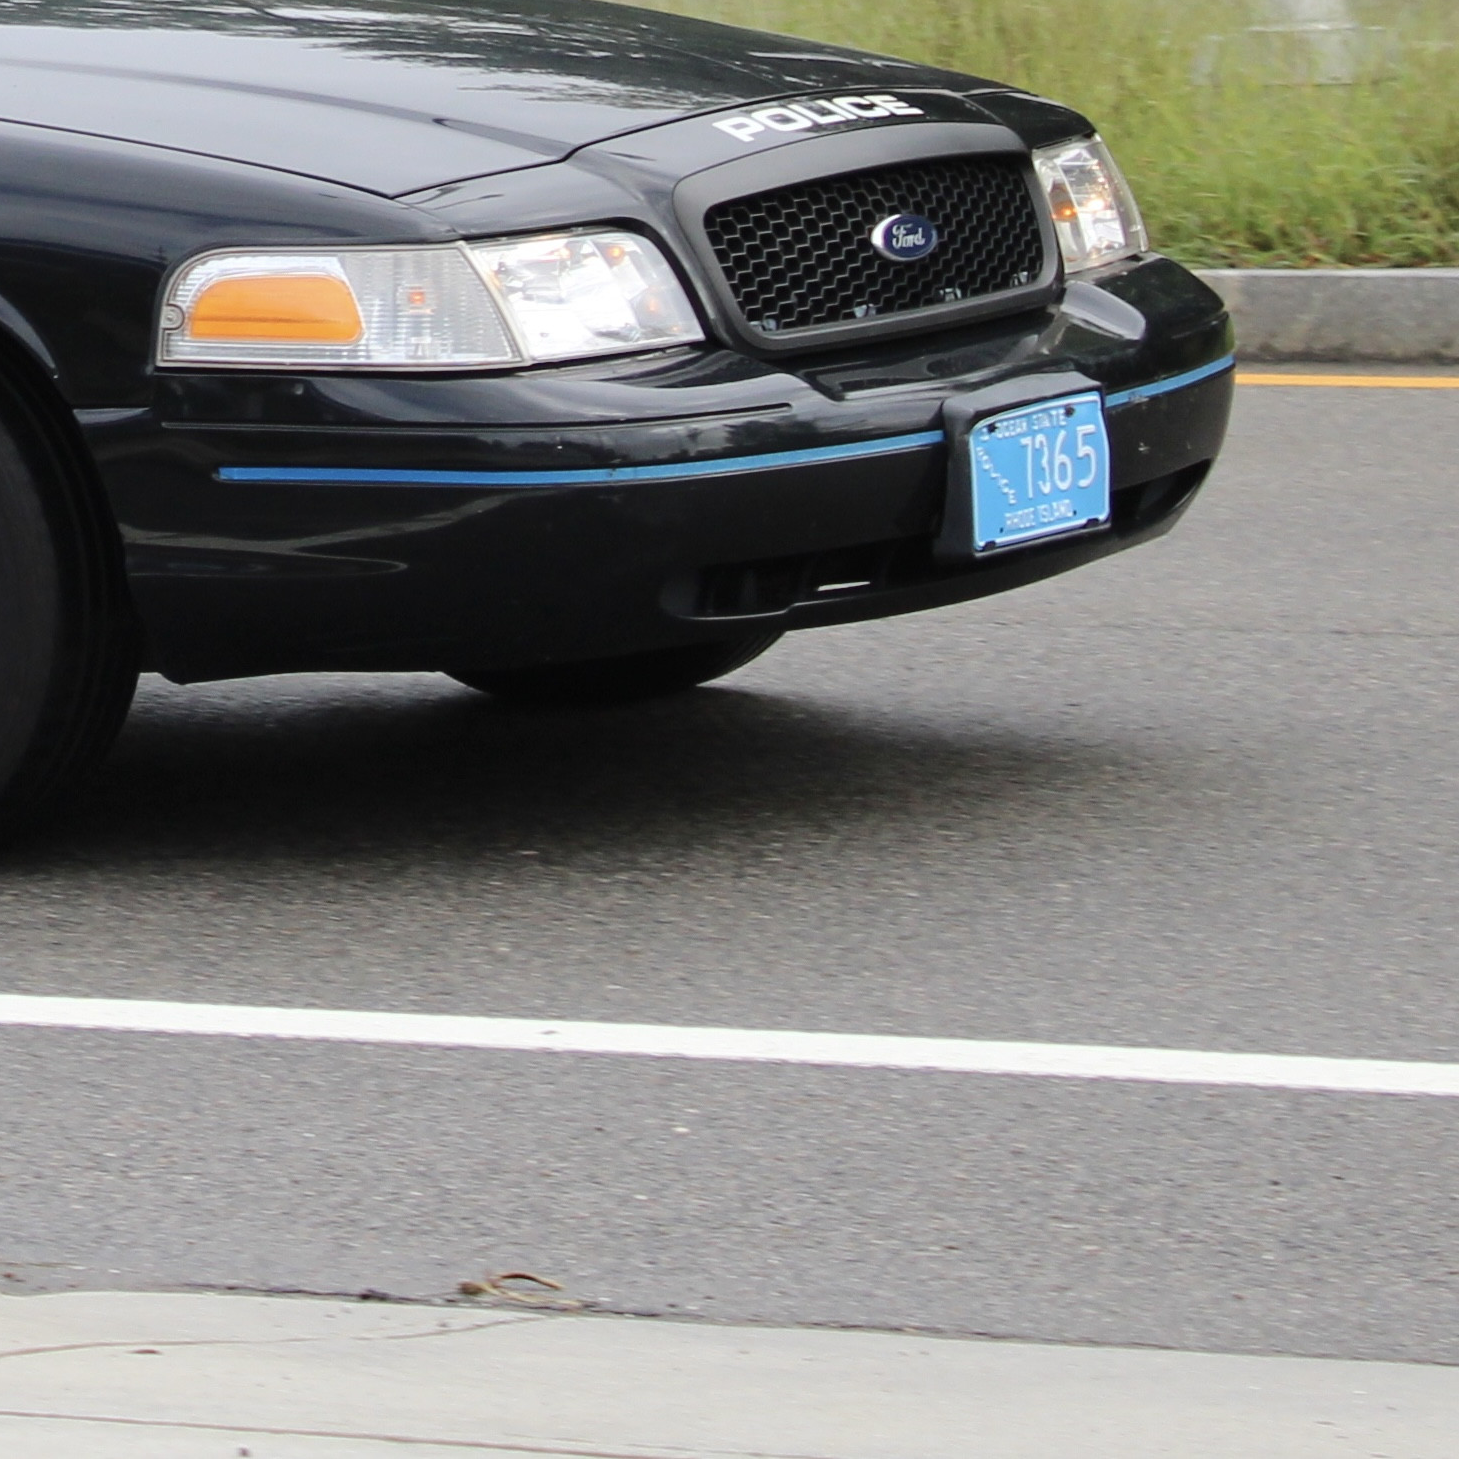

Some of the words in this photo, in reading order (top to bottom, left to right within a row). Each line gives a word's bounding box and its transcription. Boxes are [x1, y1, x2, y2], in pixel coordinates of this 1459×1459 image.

[711, 94, 924, 143] POLICE
[892, 223, 925, 249] Ford
[1020, 424, 1097, 498] 7365
